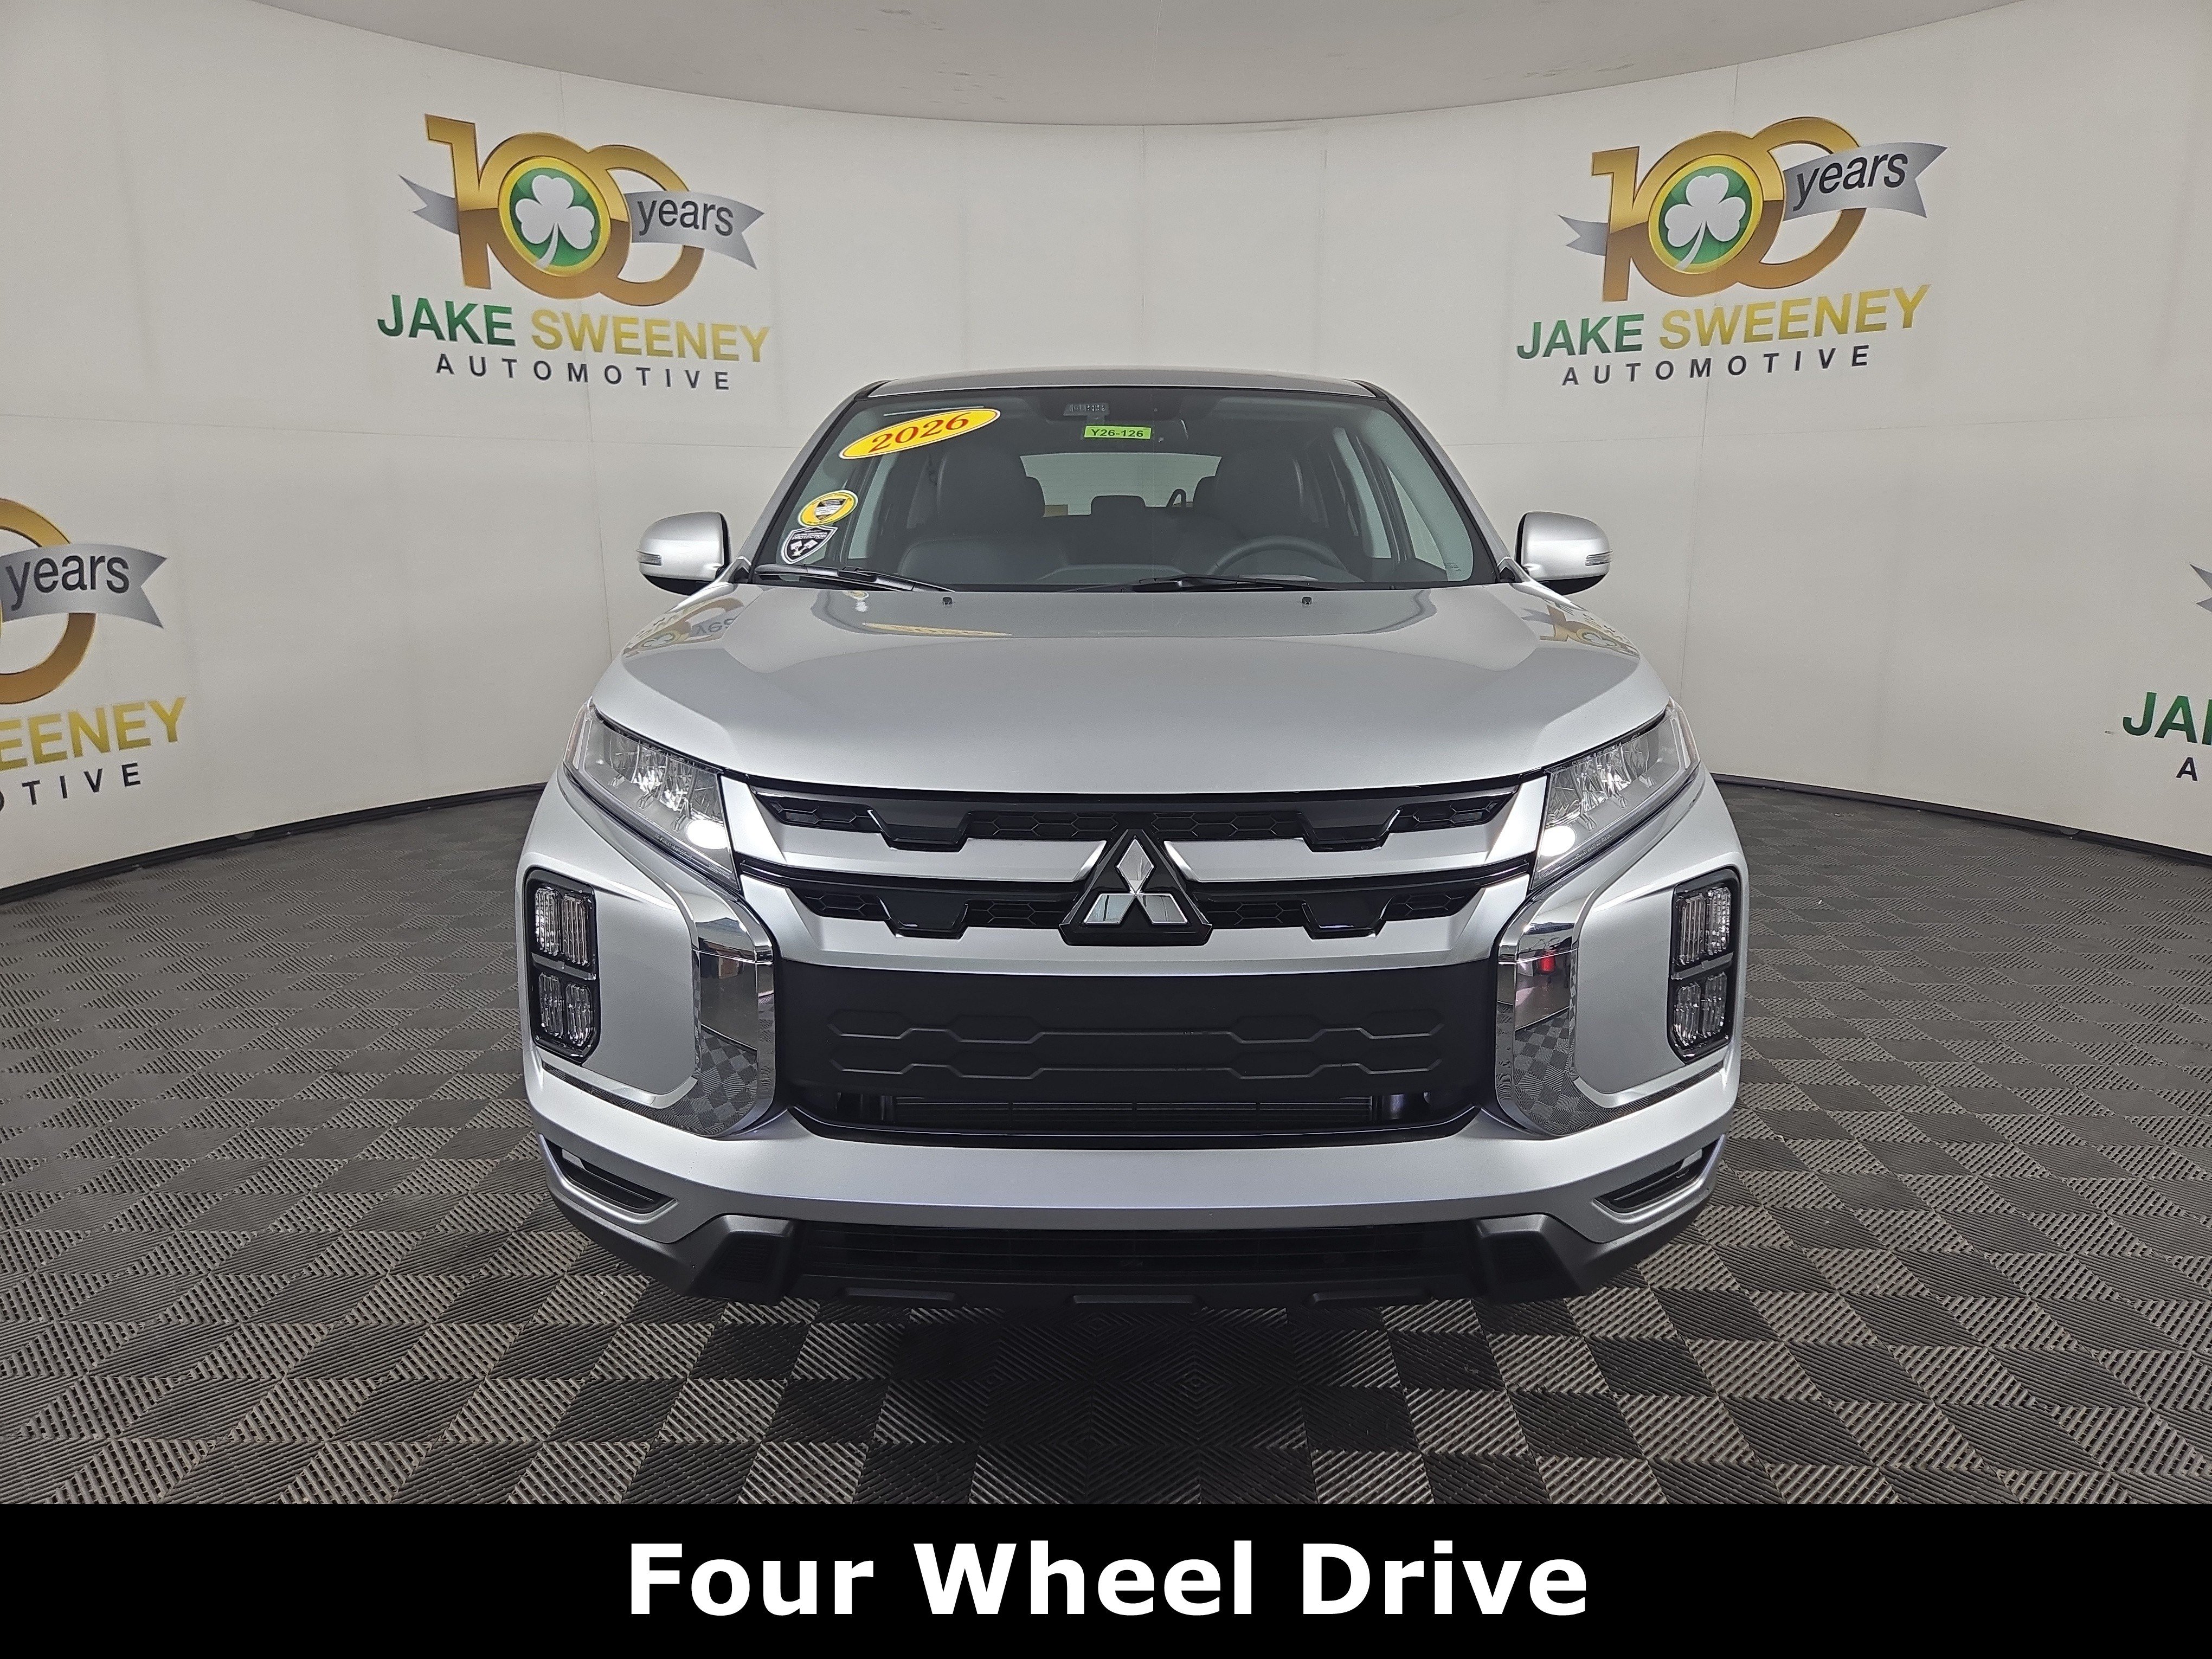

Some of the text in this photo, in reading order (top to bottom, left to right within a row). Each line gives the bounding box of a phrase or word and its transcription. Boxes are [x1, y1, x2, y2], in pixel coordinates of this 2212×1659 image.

[425, 113, 734, 306] 100 years
[1592, 116, 1907, 303] 100 years
[377, 294, 770, 362] JAKE SWEENEY
[1516, 284, 1932, 360] JAKE SWEENEY
[436, 353, 730, 390] AUTOMOTIVE
[1562, 345, 1870, 387] AUTOMOTIVE
[867, 412, 972, 453] 2026
[1091, 429, 1144, 438] Y26-126
[5, 554, 130, 611] years
[2123, 691, 2212, 746] JA
[0, 762, 141, 812] TIVE
